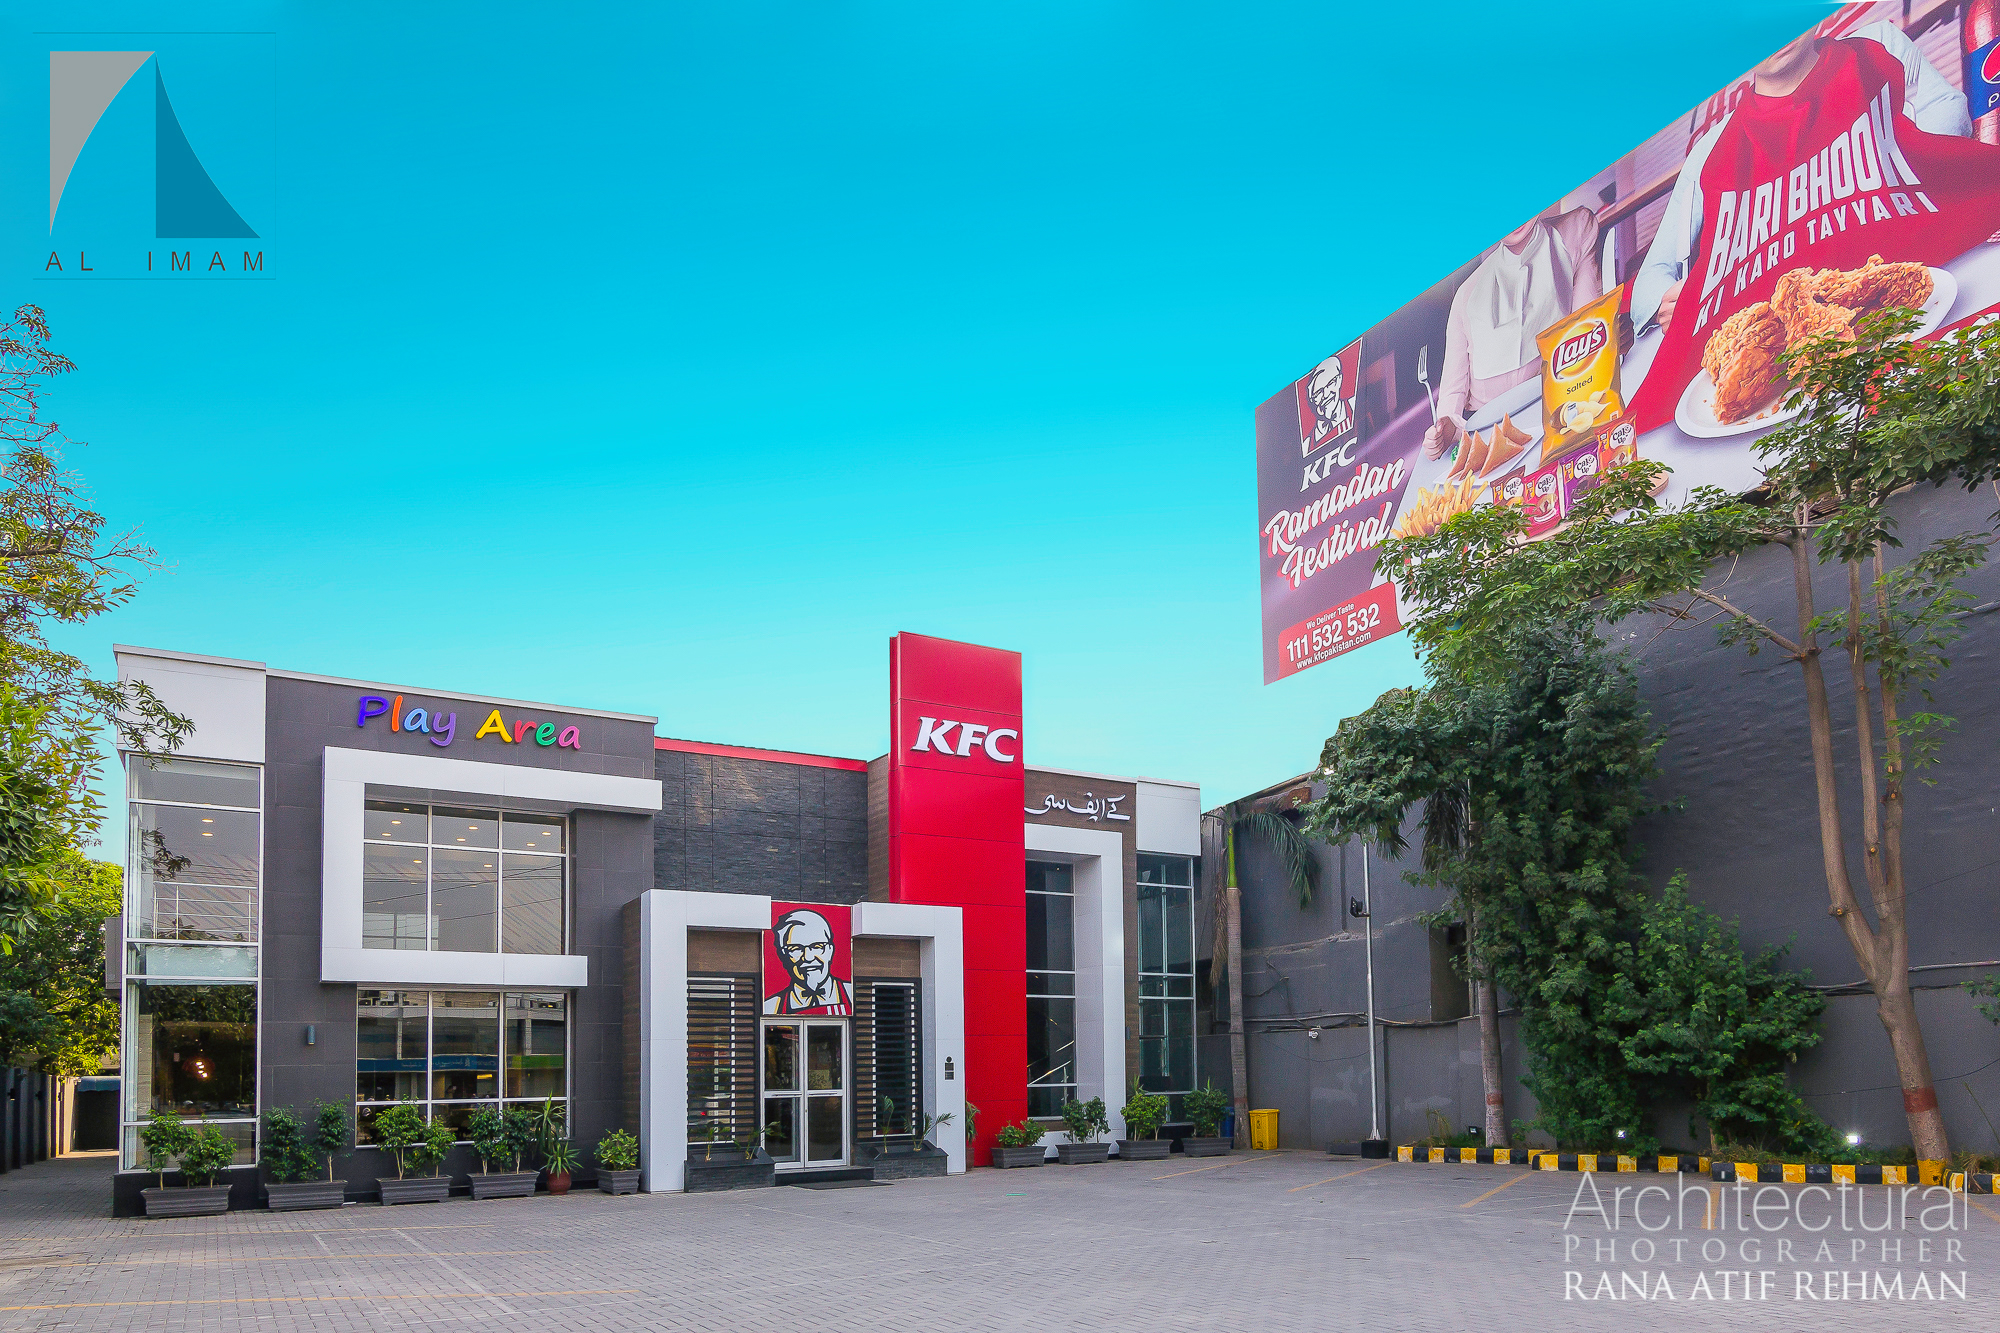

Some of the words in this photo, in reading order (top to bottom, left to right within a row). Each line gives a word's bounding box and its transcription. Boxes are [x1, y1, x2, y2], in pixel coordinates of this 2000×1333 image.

[1699, 176, 1784, 304] BARI
[1788, 81, 1922, 225] BHOOK
[1692, 284, 1725, 337] KI
[1733, 230, 1796, 298] KARO
[1806, 191, 1939, 245] TAYYARI
[1566, 375, 1593, 395] Salted
[1300, 437, 1357, 492] KFC
[1264, 458, 1405, 555] Ramadan
[1281, 501, 1391, 588] Festival
[1286, 634, 1309, 662] 111
[1312, 620, 1343, 651] 532
[1347, 603, 1380, 636] 532
[1306, 620, 1316, 630] We
[1316, 610, 1337, 626] Deliver
[1337, 603, 1355, 616] Taste
[1296, 632, 1372, 669] www.kfcpakistan.com
[357, 695, 456, 747] Play
[475, 709, 581, 750] Area
[911, 716, 1018, 762] KFC
[1107, 794, 1131, 821] کے
